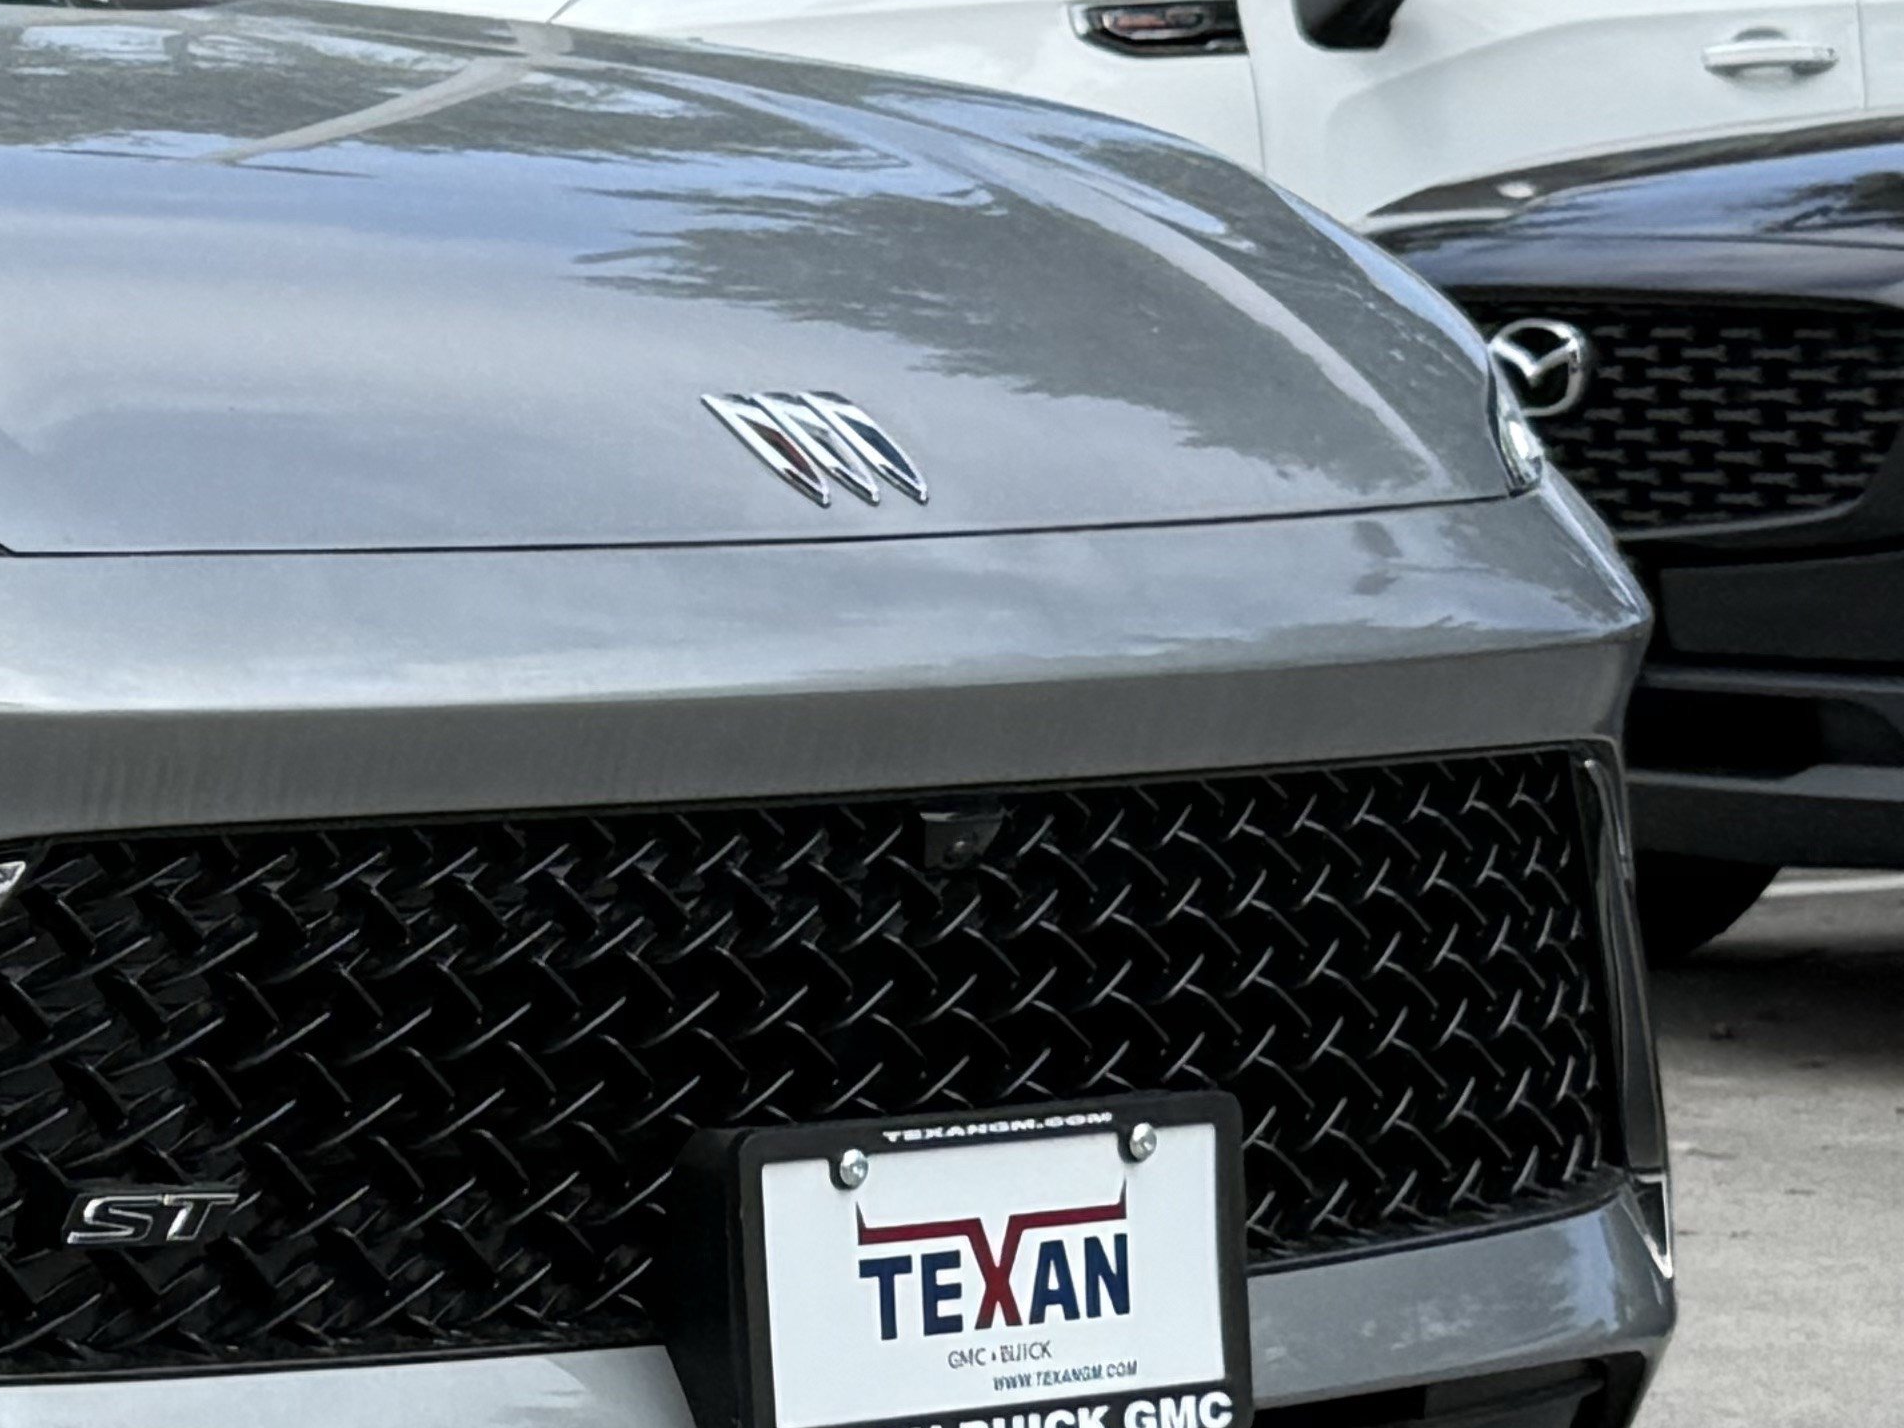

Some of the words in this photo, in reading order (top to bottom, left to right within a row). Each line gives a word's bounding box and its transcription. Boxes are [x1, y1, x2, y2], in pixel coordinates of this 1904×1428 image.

[882, 1111, 1113, 1142] TEXANGM.COM
[65, 1191, 240, 1245] ST
[858, 1217, 1130, 1341] TEXAN
[947, 1347, 987, 1369] GMC
[1000, 1339, 1053, 1364] BUICK
